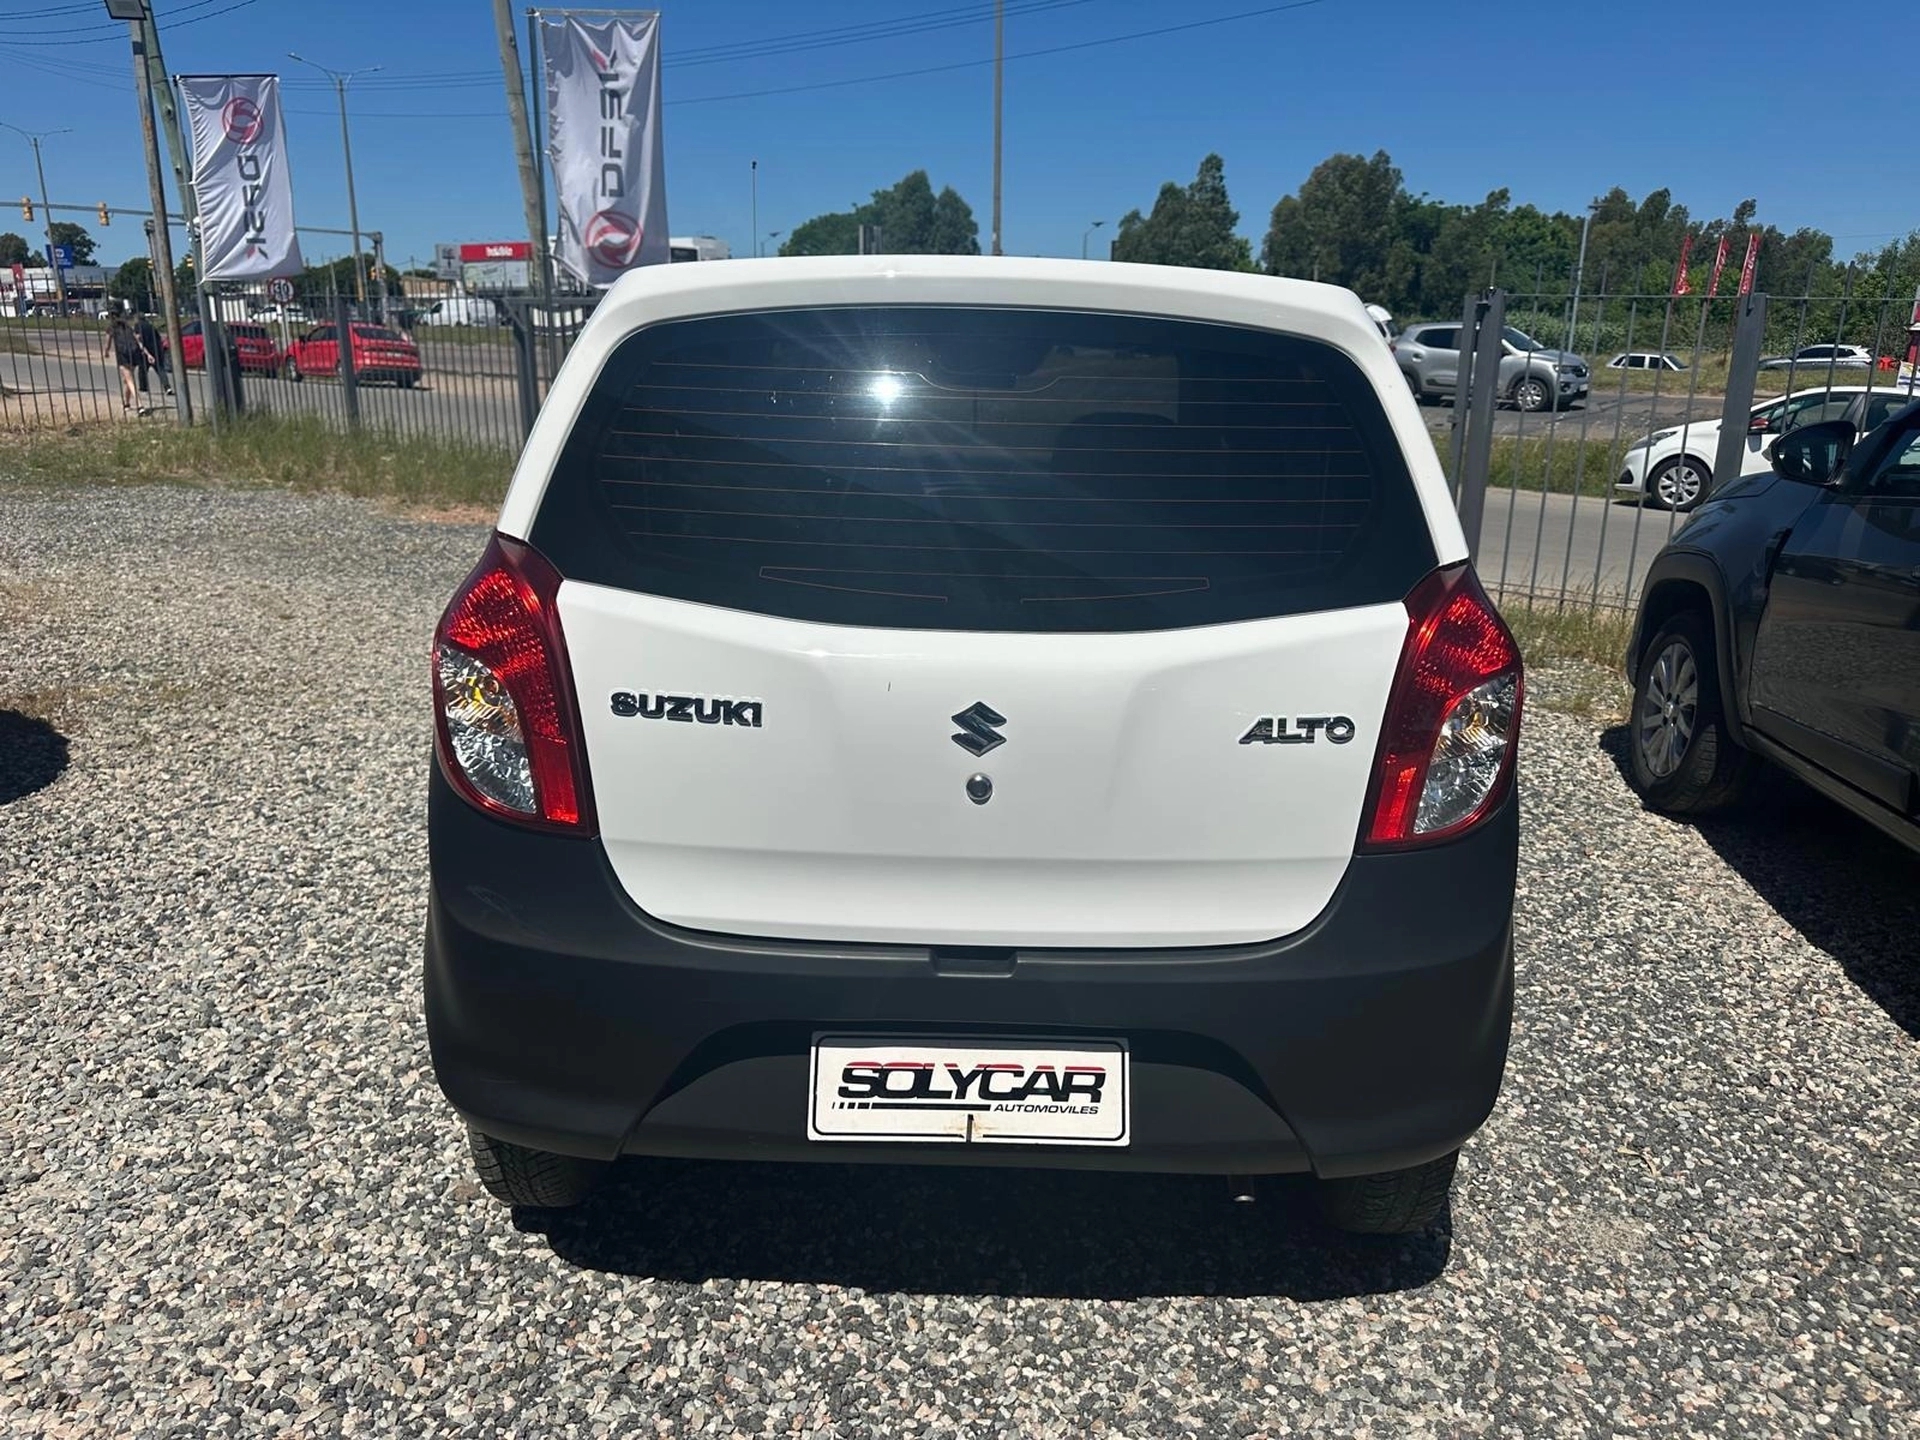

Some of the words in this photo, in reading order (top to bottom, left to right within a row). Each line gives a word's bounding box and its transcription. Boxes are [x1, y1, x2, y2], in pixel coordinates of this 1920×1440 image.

[610, 691, 763, 727] SUZUKI
[1238, 715, 1356, 744] ALTO
[837, 1061, 1106, 1103] SOLYCAR
[994, 1103, 1099, 1115] AUTOMOVILES
